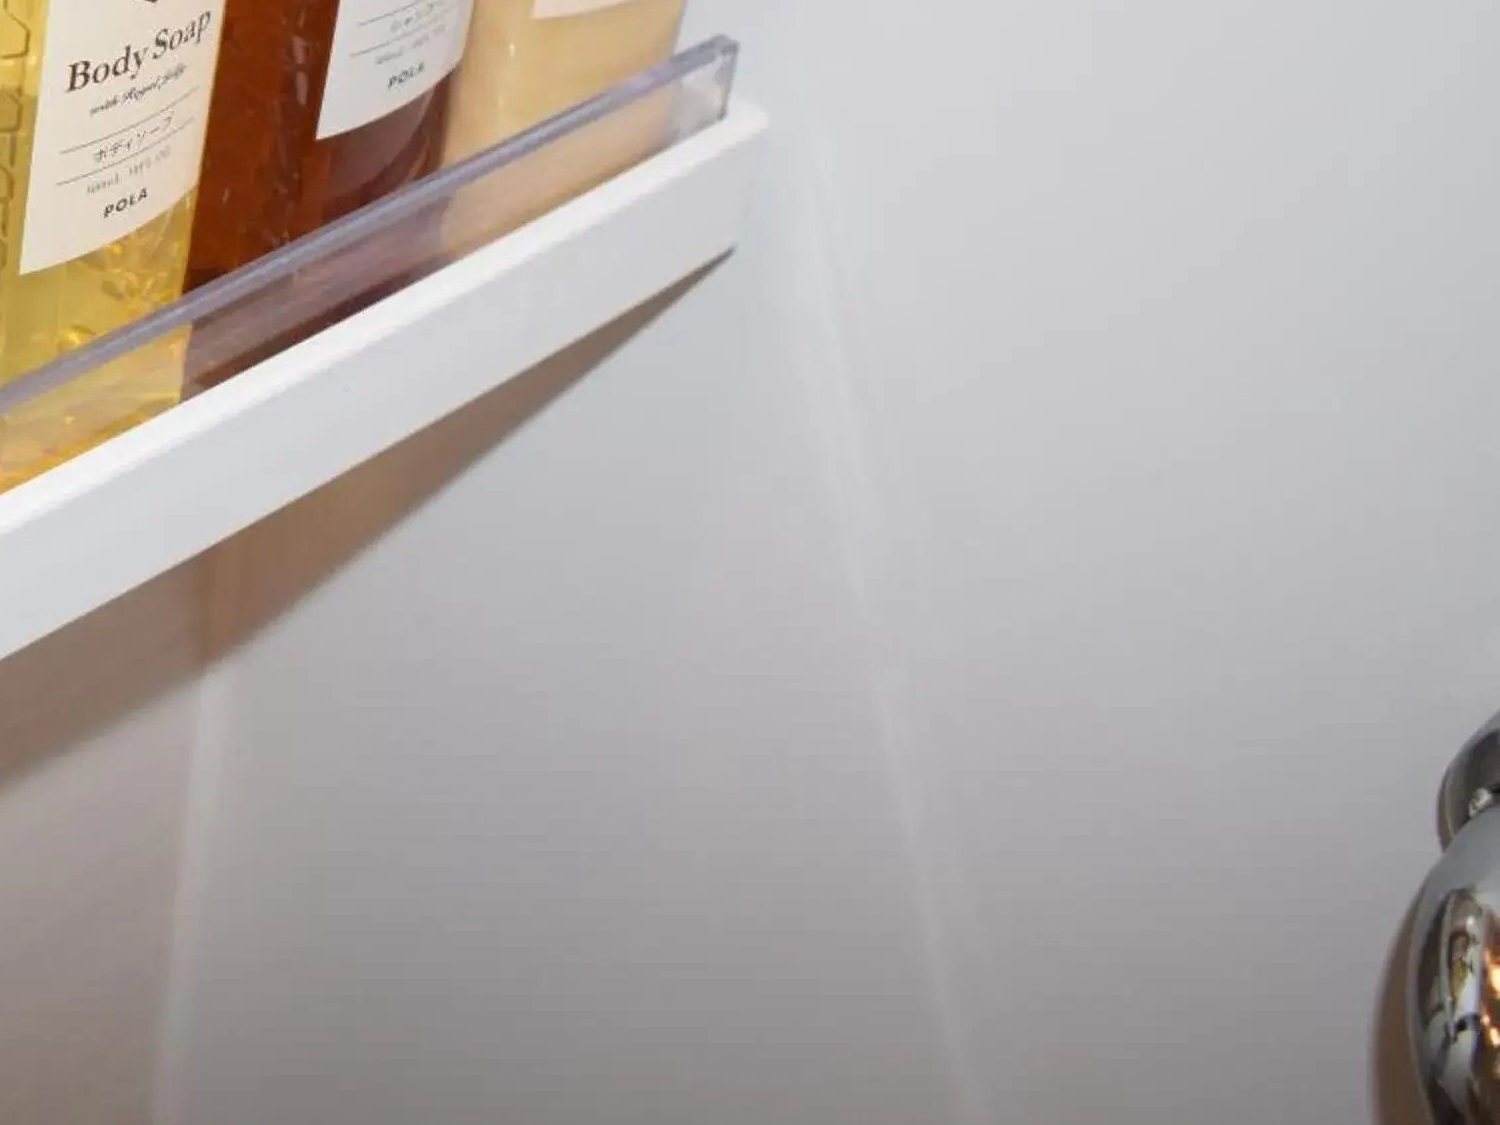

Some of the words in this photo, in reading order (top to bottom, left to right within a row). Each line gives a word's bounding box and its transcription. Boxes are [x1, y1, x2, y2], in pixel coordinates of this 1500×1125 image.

[66, 44, 148, 92] Body
[153, 10, 212, 59] Soap
[102, 187, 149, 219] POLA
